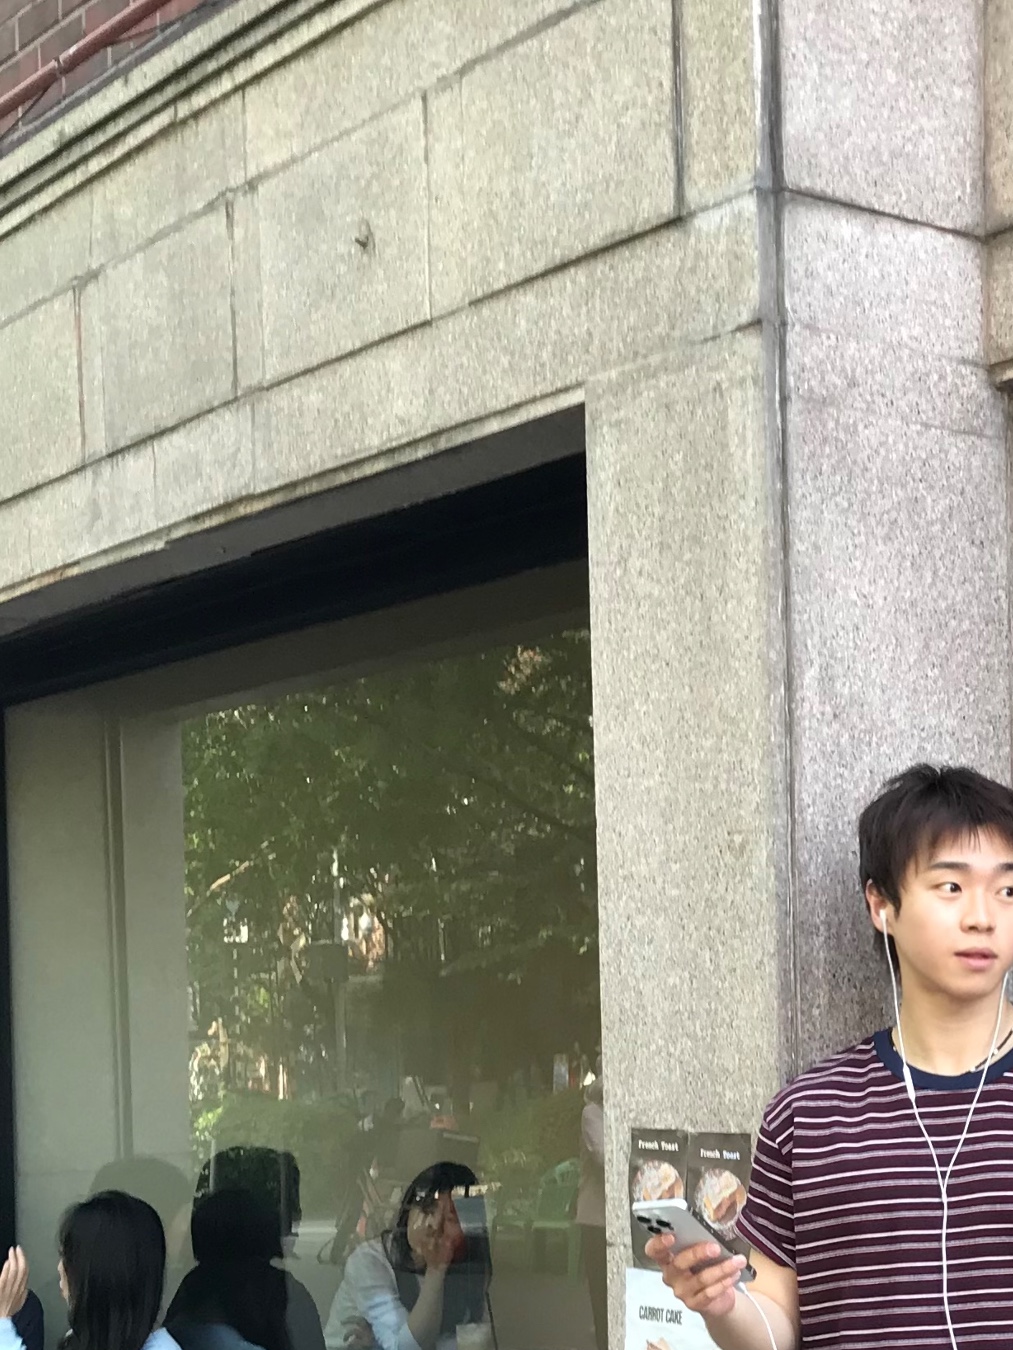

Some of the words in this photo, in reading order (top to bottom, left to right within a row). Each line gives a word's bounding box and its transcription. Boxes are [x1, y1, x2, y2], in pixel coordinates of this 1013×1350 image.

[638, 1139, 660, 1150] French
[660, 1140, 679, 1152] Toast
[700, 1147, 721, 1159] French
[722, 1149, 740, 1161] Toast
[639, 1305, 664, 1323] CARROT
[665, 1309, 683, 1325] CAKE
